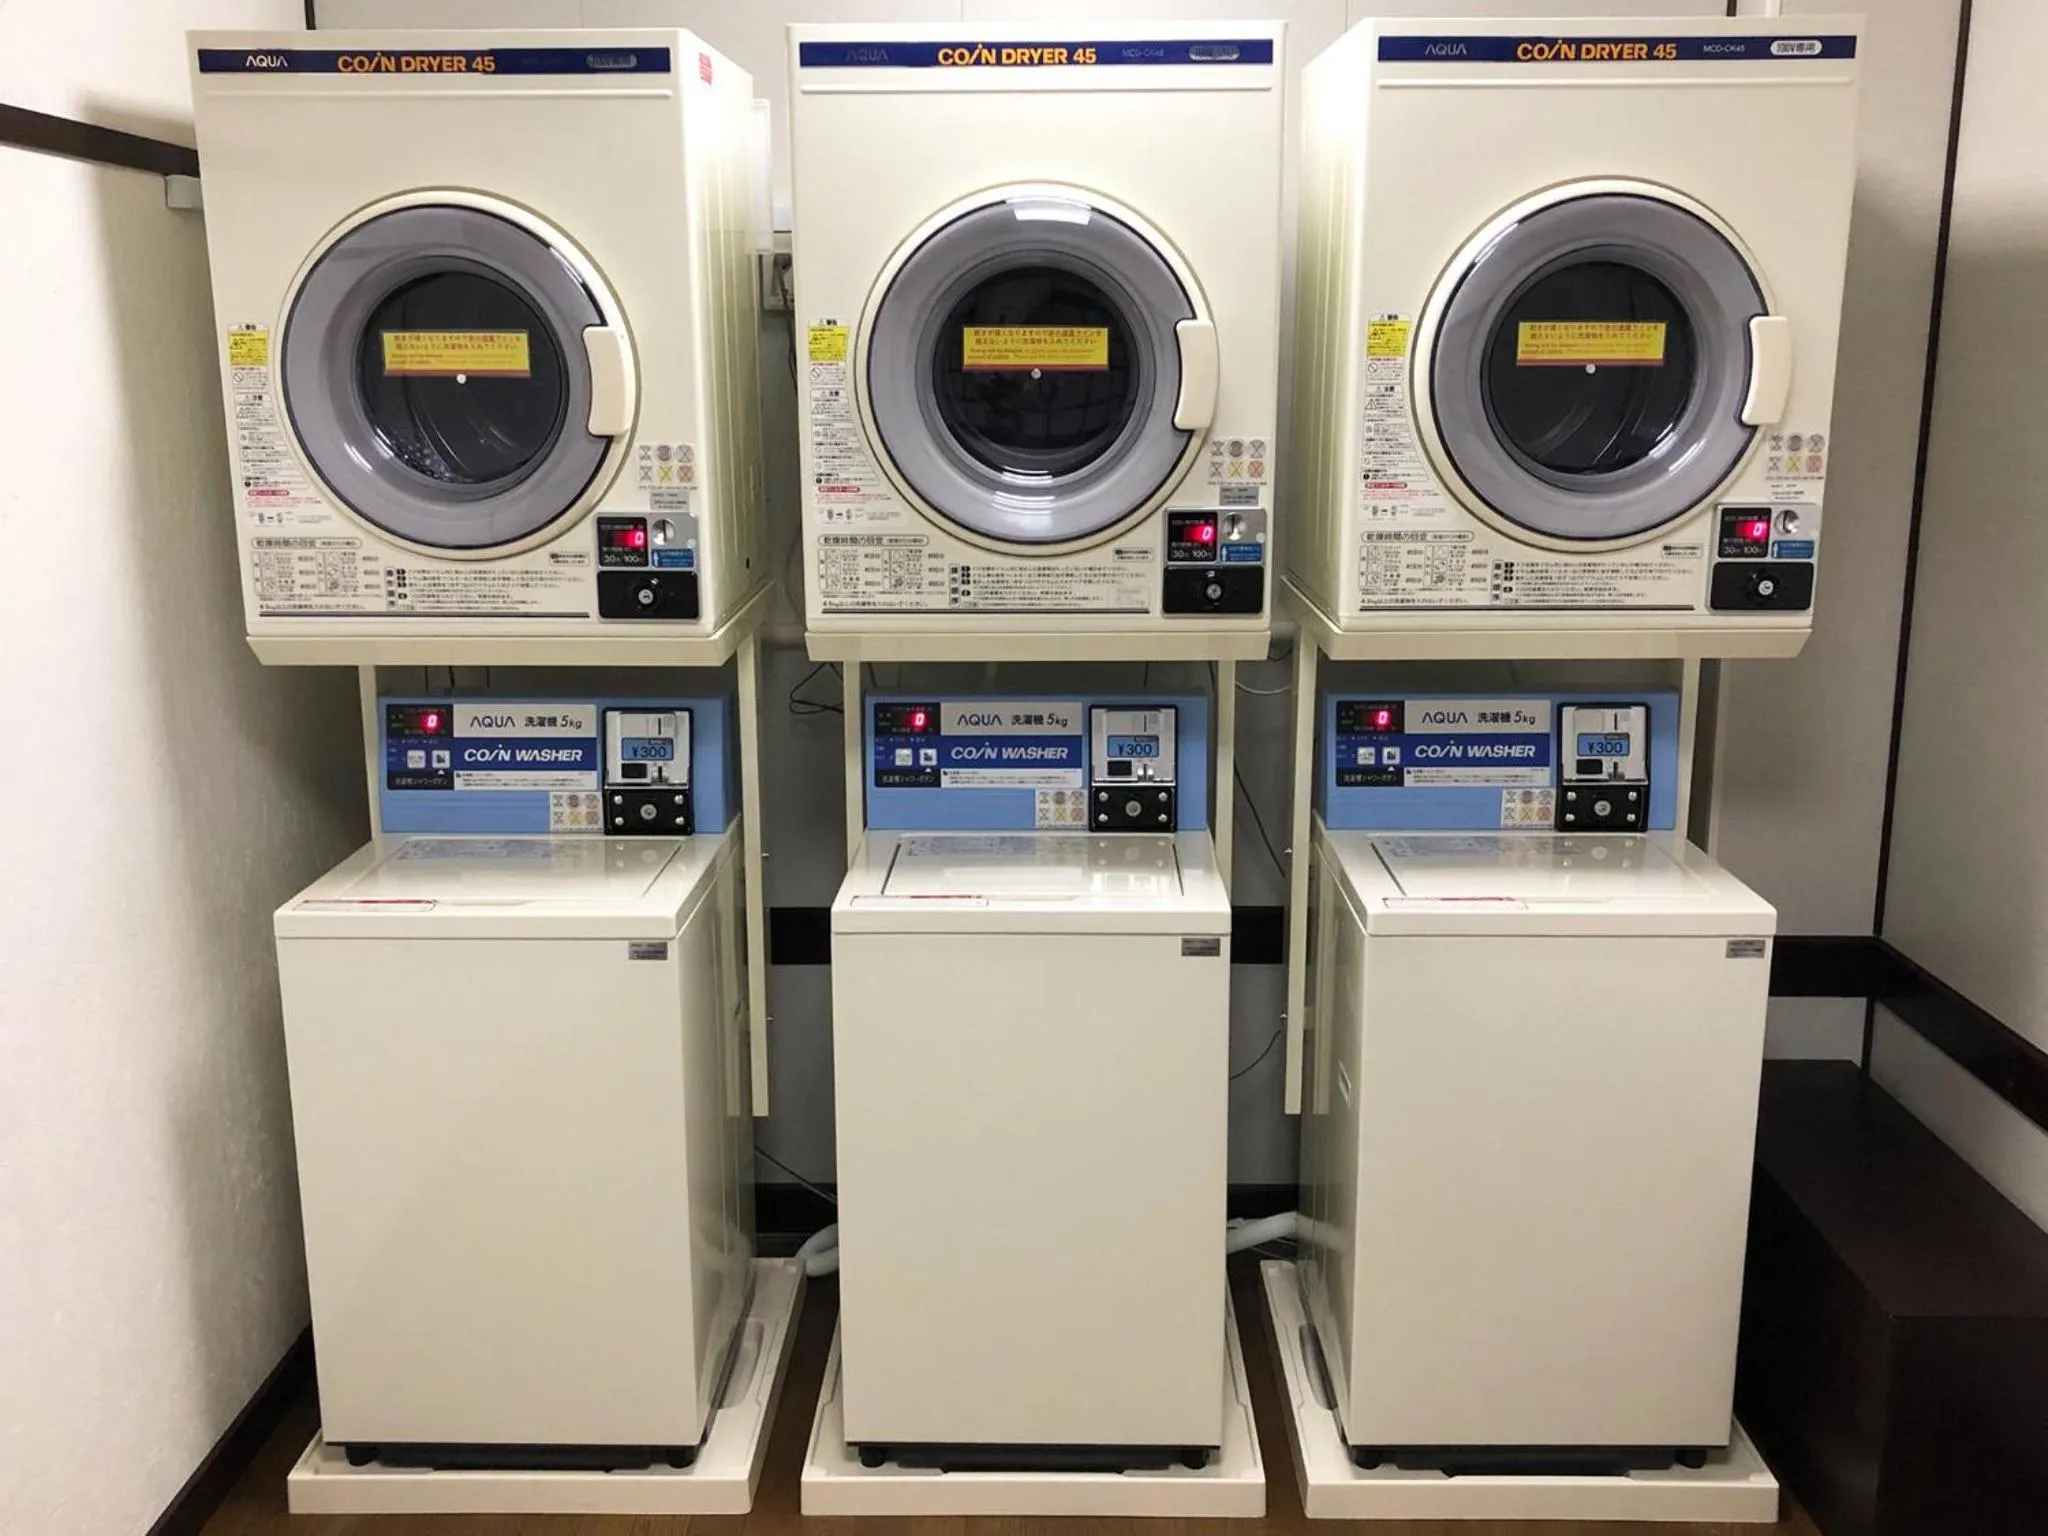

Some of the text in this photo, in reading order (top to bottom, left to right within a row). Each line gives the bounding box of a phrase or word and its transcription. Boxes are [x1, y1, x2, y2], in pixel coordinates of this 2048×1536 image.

[845, 48, 889, 61] AQUA
[1002, 48, 1068, 64] DRYER
[1073, 48, 1097, 63] 45
[1425, 43, 1467, 55] AQUA
[1581, 44, 1648, 60] DRYER
[1652, 43, 1677, 60] 45
[245, 55, 288, 68] AQUA
[401, 56, 468, 72] DRYER
[472, 55, 496, 72] 45
[1202, 525, 1214, 541] 0
[1753, 523, 1763, 537] 0
[427, 714, 438, 728] 0
[470, 714, 582, 731] AQUA 洗濯機 5kg
[915, 712, 925, 726] 0
[956, 712, 1069, 728] AQUA 洗濯機 5kg
[1378, 710, 1388, 724] 0
[1421, 711, 1536, 726] AQUA 洗濯機 5kg
[631, 746, 667, 759] ¥300
[1000, 746, 1069, 760] WASHER
[1117, 743, 1153, 756] ¥300
[1467, 745, 1536, 758] WASHER
[1586, 741, 1623, 754] ¥300
[515, 748, 583, 762] WASHER
